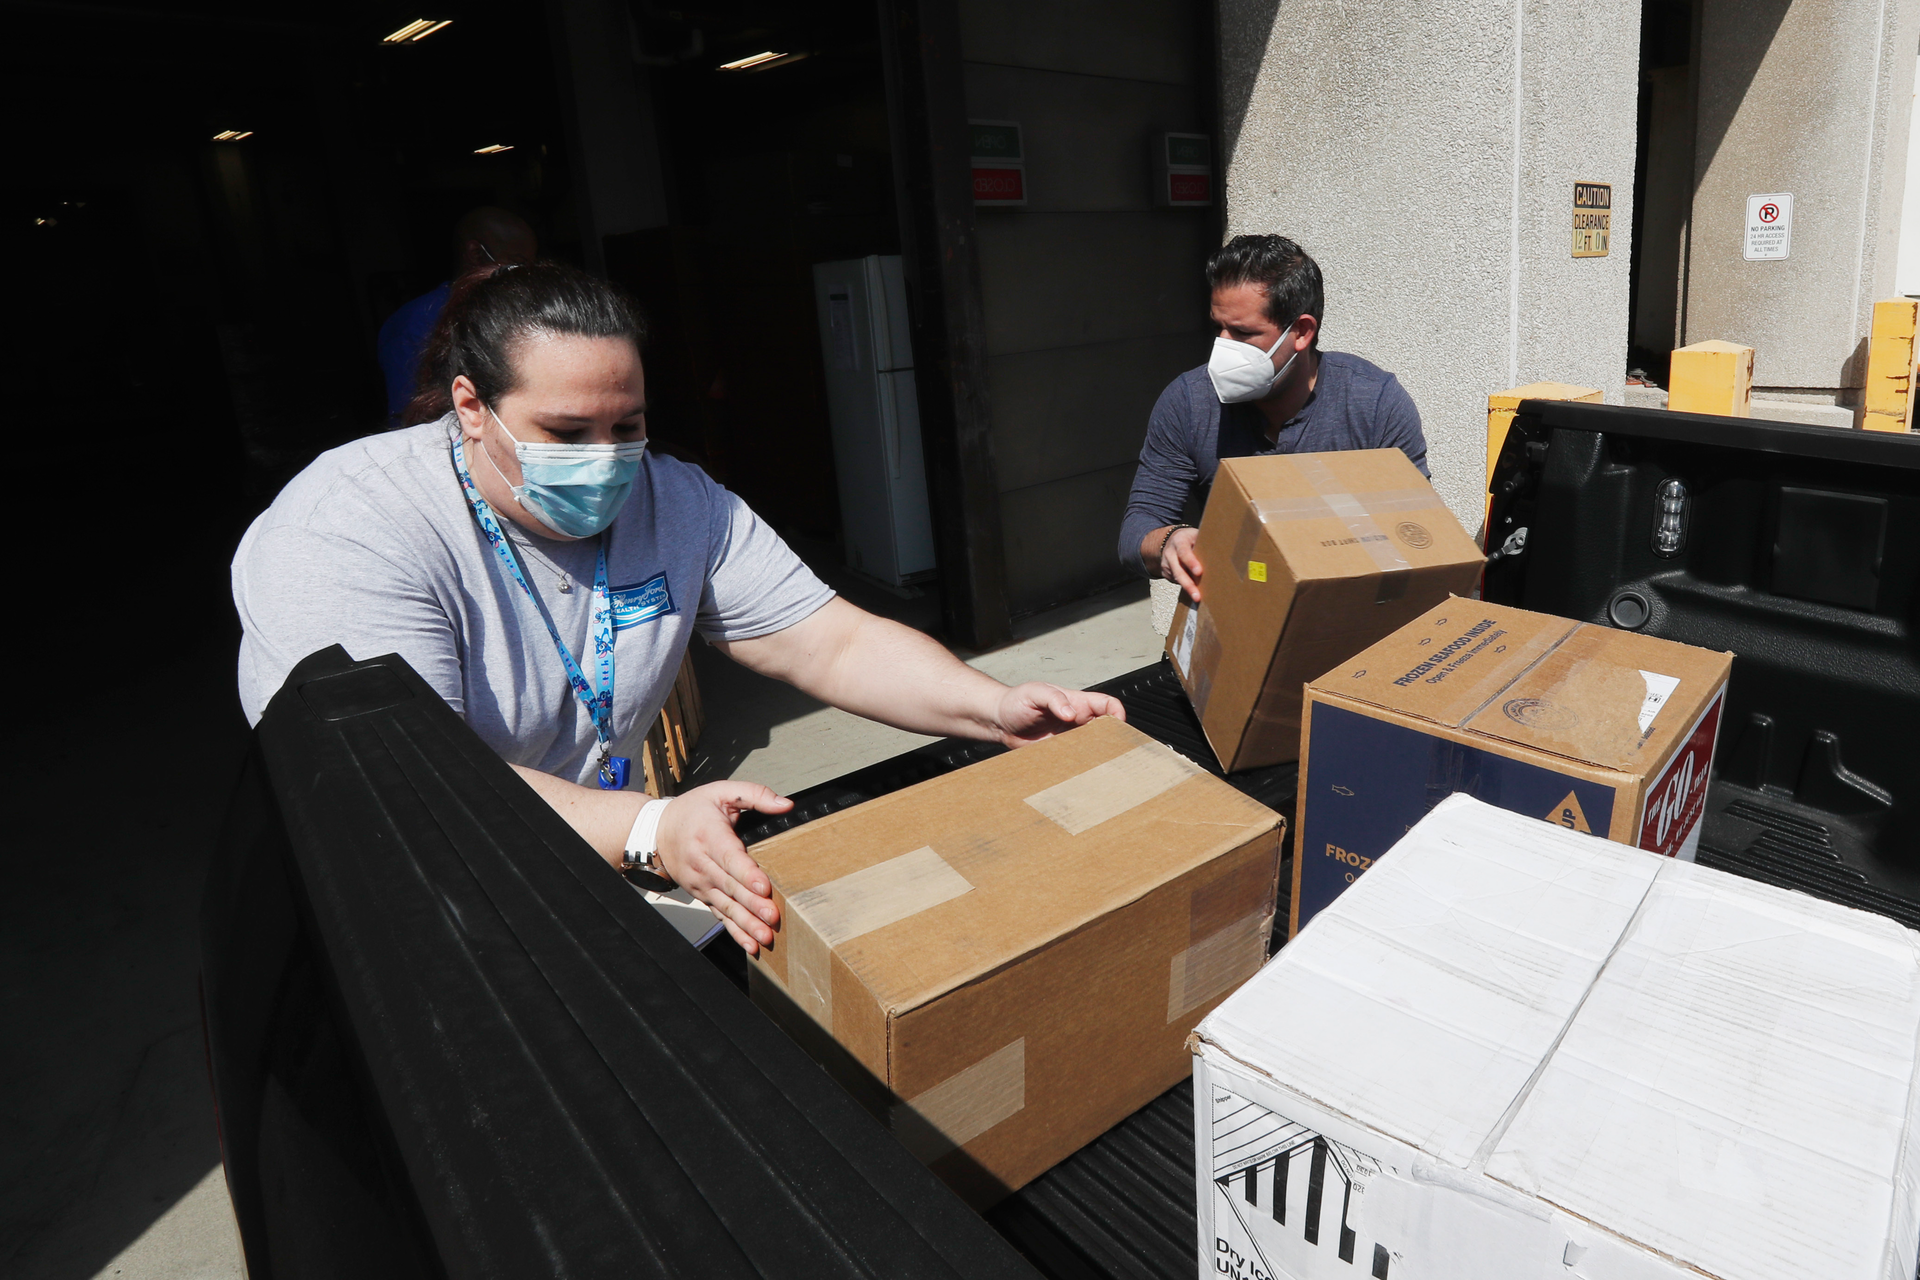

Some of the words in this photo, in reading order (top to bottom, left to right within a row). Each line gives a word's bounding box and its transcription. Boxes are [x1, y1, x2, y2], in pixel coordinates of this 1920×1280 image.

[1576, 186, 1609, 206] CAUTION
[1574, 213, 1609, 230] CLEARANCE
[1575, 230, 1583, 250] 12
[644, 582, 664, 599] Ford
[611, 605, 640, 614] HEALTH
[1393, 661, 1437, 687] FROZEN
[1428, 636, 1472, 663] SEAFOOD
[1464, 619, 1497, 638] INSIDE
[1425, 671, 1449, 683] Open
[1447, 653, 1473, 668] Freeze
[1466, 629, 1507, 654] Immediately
[601, 659, 609, 685] Stitch
[1562, 808, 1576, 830] UP
[1325, 843, 1376, 871] FROZ
[1345, 872, 1358, 883] O
[1216, 1237, 1245, 1269] Dry
[1216, 1257, 1249, 1280] UN
